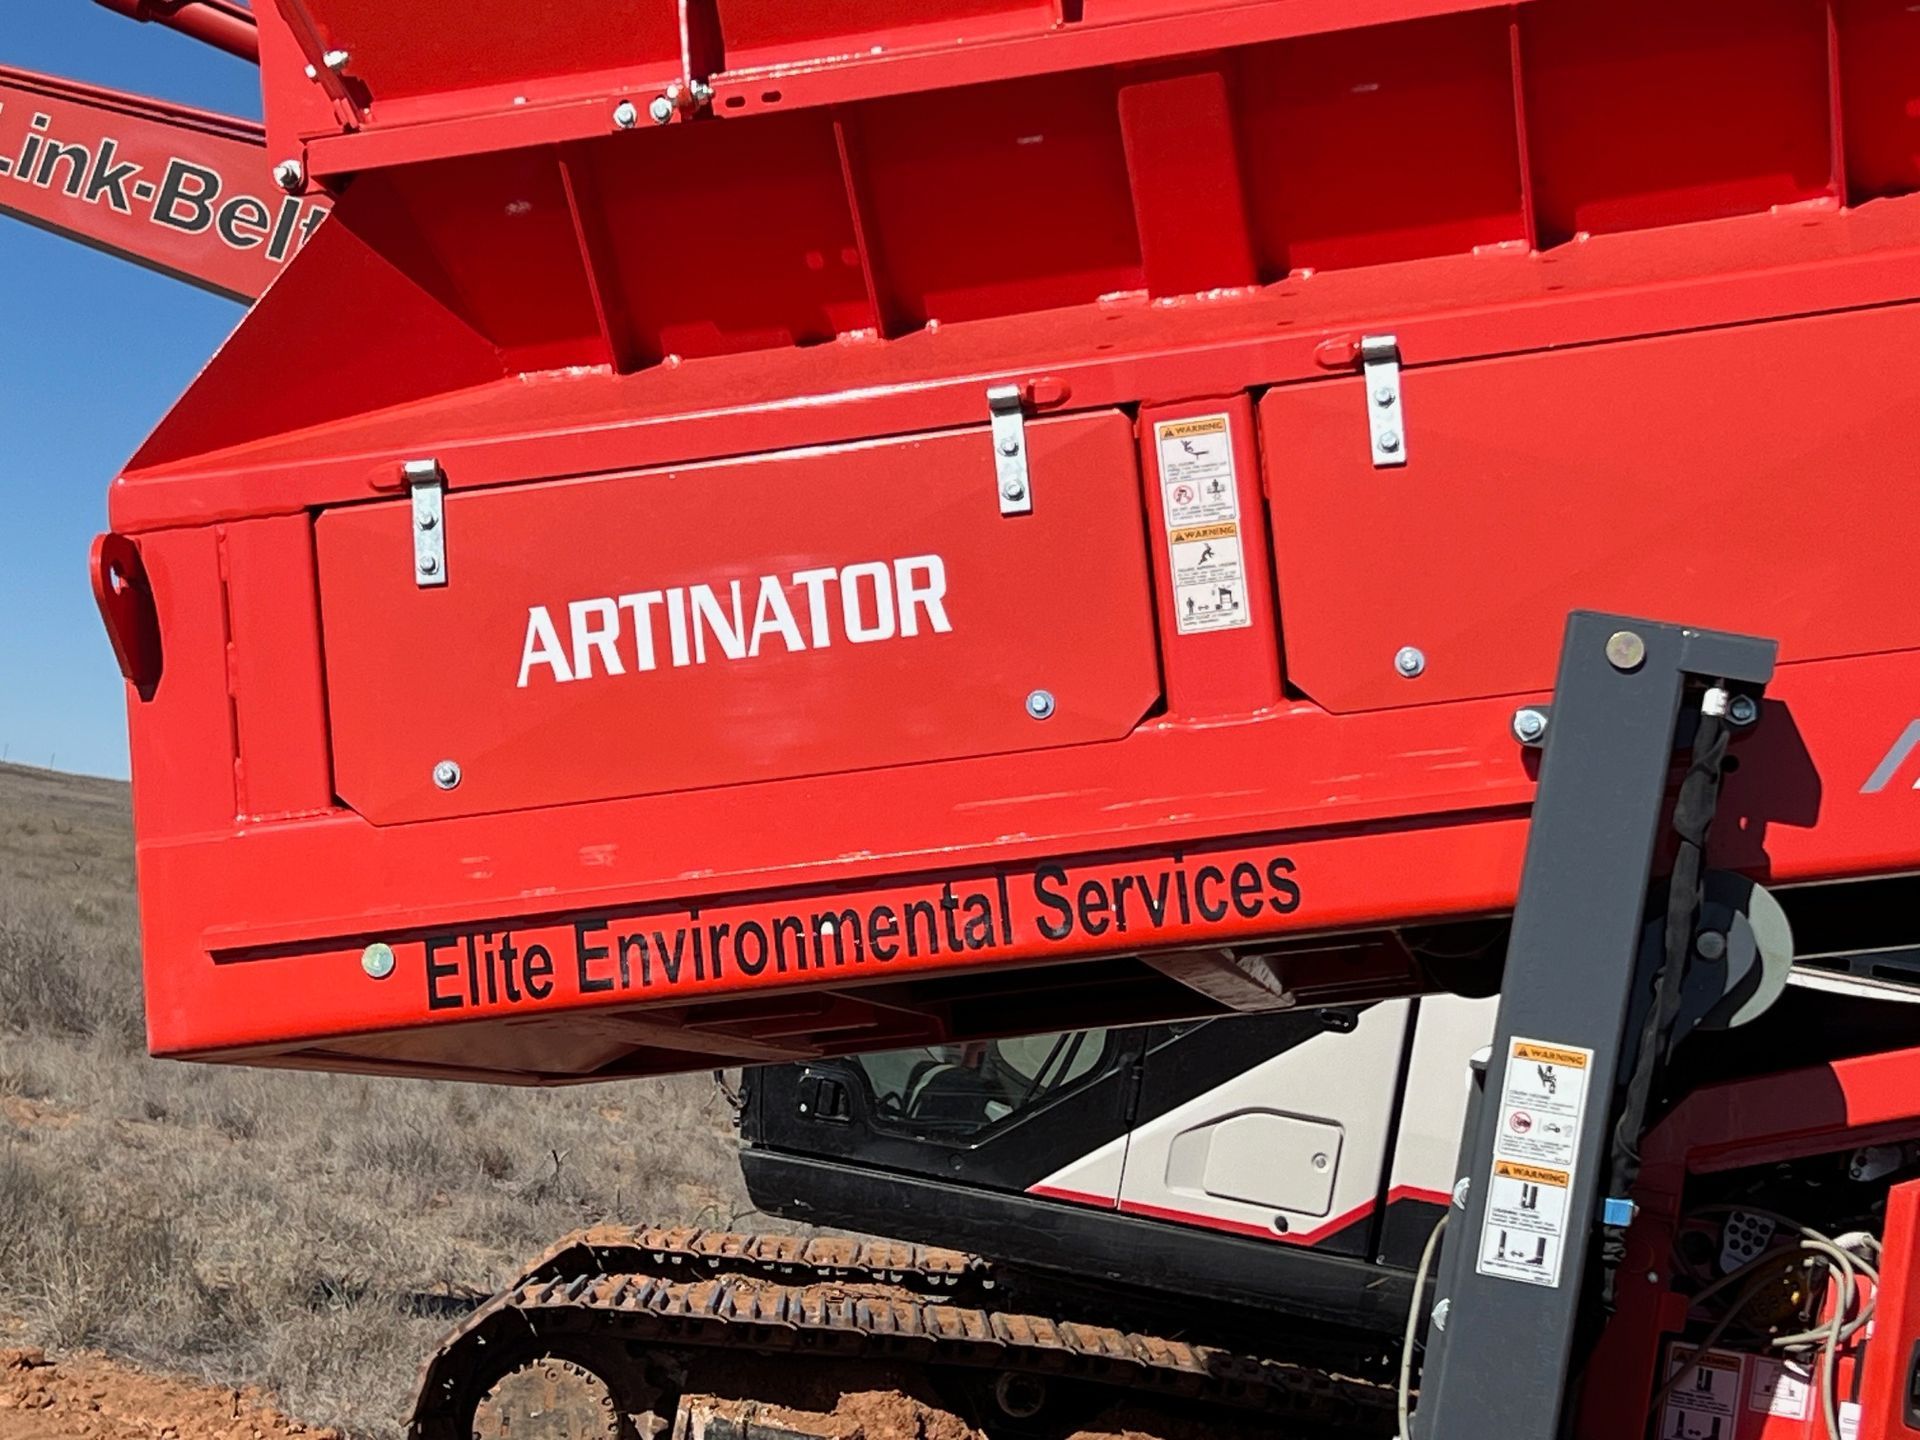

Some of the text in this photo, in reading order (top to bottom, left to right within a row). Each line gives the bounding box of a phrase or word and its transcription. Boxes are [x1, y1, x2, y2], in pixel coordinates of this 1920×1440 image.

[1175, 421, 1223, 434] WARNING
[1185, 526, 1235, 539] WARNING
[517, 554, 953, 687] ARTINATOR
[424, 851, 1302, 1010] Elite Environmental Services
[1531, 1050, 1584, 1066] WARNING
[1513, 1166, 1566, 1184] WARNING
